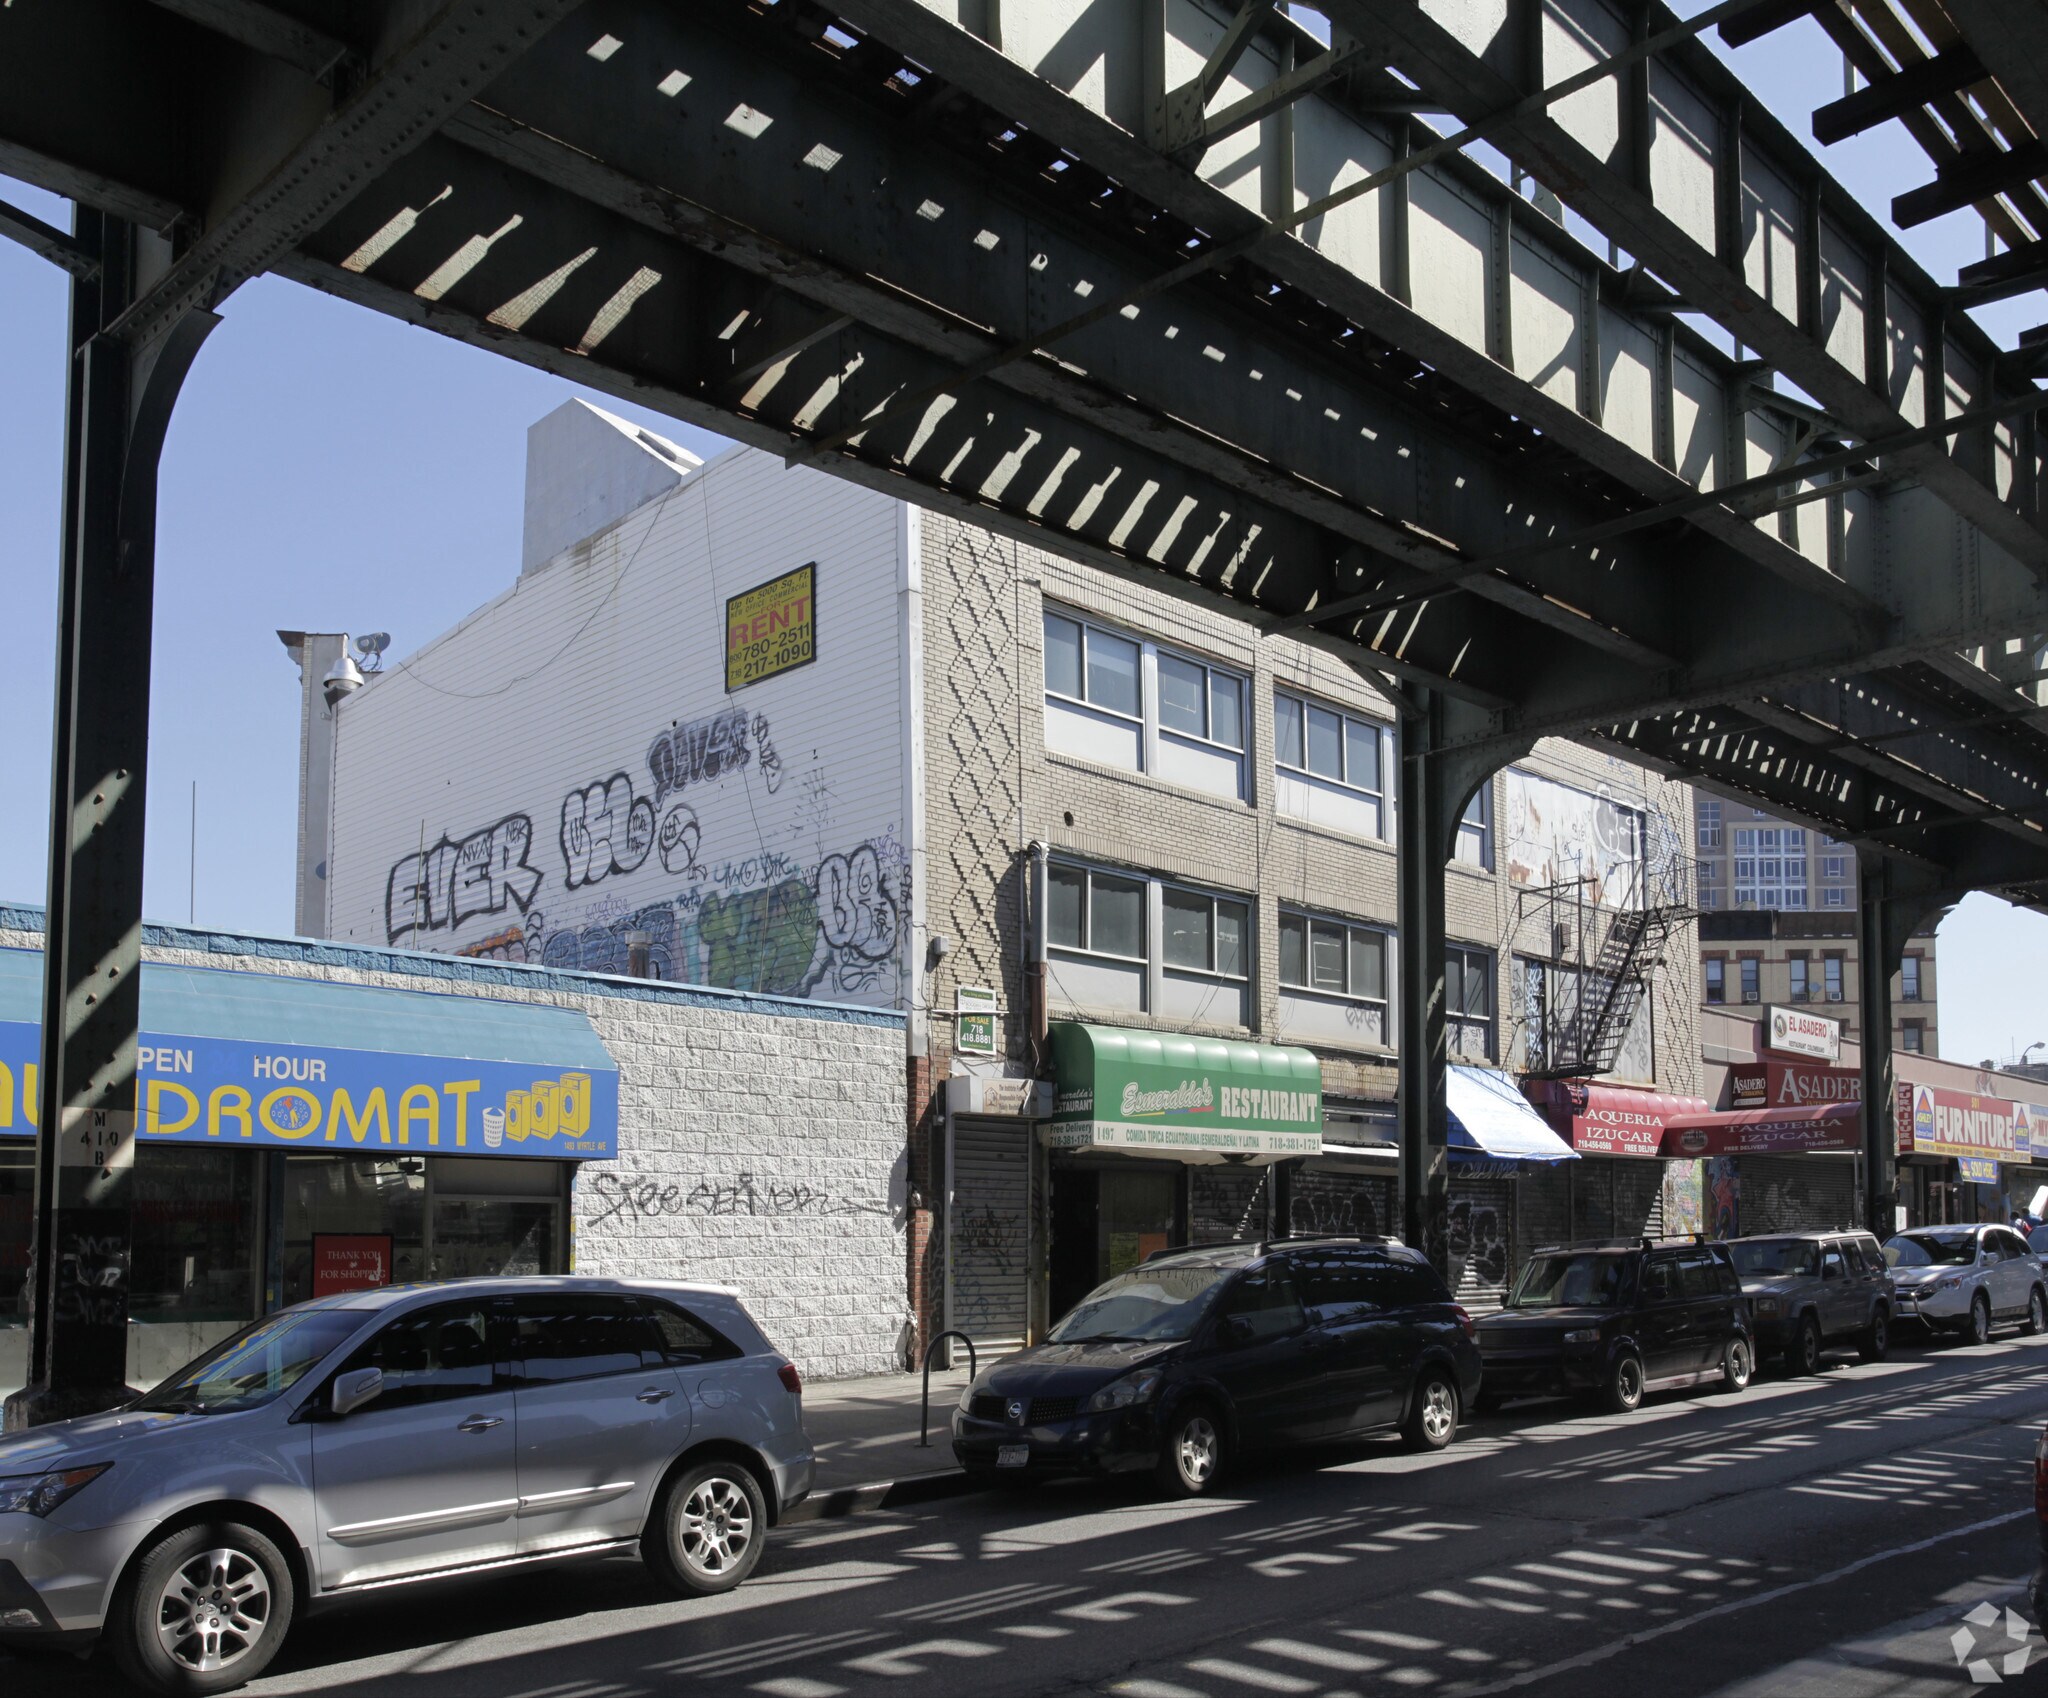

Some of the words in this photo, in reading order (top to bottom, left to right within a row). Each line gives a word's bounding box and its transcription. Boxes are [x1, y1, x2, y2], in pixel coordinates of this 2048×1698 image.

[731, 600, 742, 611] Up
[745, 594, 755, 605] to
[757, 584, 778, 600] 5000
[798, 570, 809, 582] Ft.
[745, 600, 765, 614] OFFICE
[769, 581, 808, 602] COMMERCIAL
[760, 600, 781, 614] FOR
[729, 595, 810, 650] RENT
[743, 622, 810, 662] 780-2511
[743, 640, 811, 679] 217-1090
[965, 1015, 976, 1023] FOR
[977, 1016, 990, 1025] SALE
[1789, 1016, 1797, 1032] EL
[1798, 1018, 1827, 1038] ASADERO
[970, 1024, 984, 1035] 718
[961, 1033, 991, 1044] 418.8881
[137, 1046, 194, 1073] PEN
[253, 1055, 327, 1082] HOUR
[1732, 1076, 1766, 1095] ASADERO
[1777, 1068, 1862, 1103] ASADER
[1120, 1077, 1214, 1117] Esmeralda's
[1220, 1086, 1318, 1122] RESTAURANT
[1574, 1107, 1664, 1127] TAQUERIA
[1899, 1084, 1912, 1146] FURNITURE
[1050, 1124, 1064, 1133] Free
[1065, 1122, 1093, 1133] Delivery
[1725, 1117, 1843, 1133] TAQUERIA
[1935, 1105, 2014, 1149] FURNITURE
[1050, 1135, 1092, 1146] 718-381-1721
[1097, 1126, 1115, 1142] 1497
[1125, 1129, 1147, 1142] COMIDA
[1149, 1130, 1165, 1143] TIPICA
[1165, 1131, 1200, 1145] ECUATORIANA
[1237, 1135, 1242, 1147] Y
[1243, 1136, 1260, 1148] LATINA
[1269, 1137, 1320, 1151] 718-381-1721
[1586, 1127, 1654, 1143] IZUCAR
[1740, 1130, 1828, 1143] IZUCAR
[1624, 1144, 1638, 1153] FREE
[94, 1150, 104, 1166] B
[1970, 1161, 1982, 1177] SOLD
[327, 1250, 360, 1260] THANK
[362, 1251, 381, 1261] YOU
[320, 1269, 339, 1279] FOR
